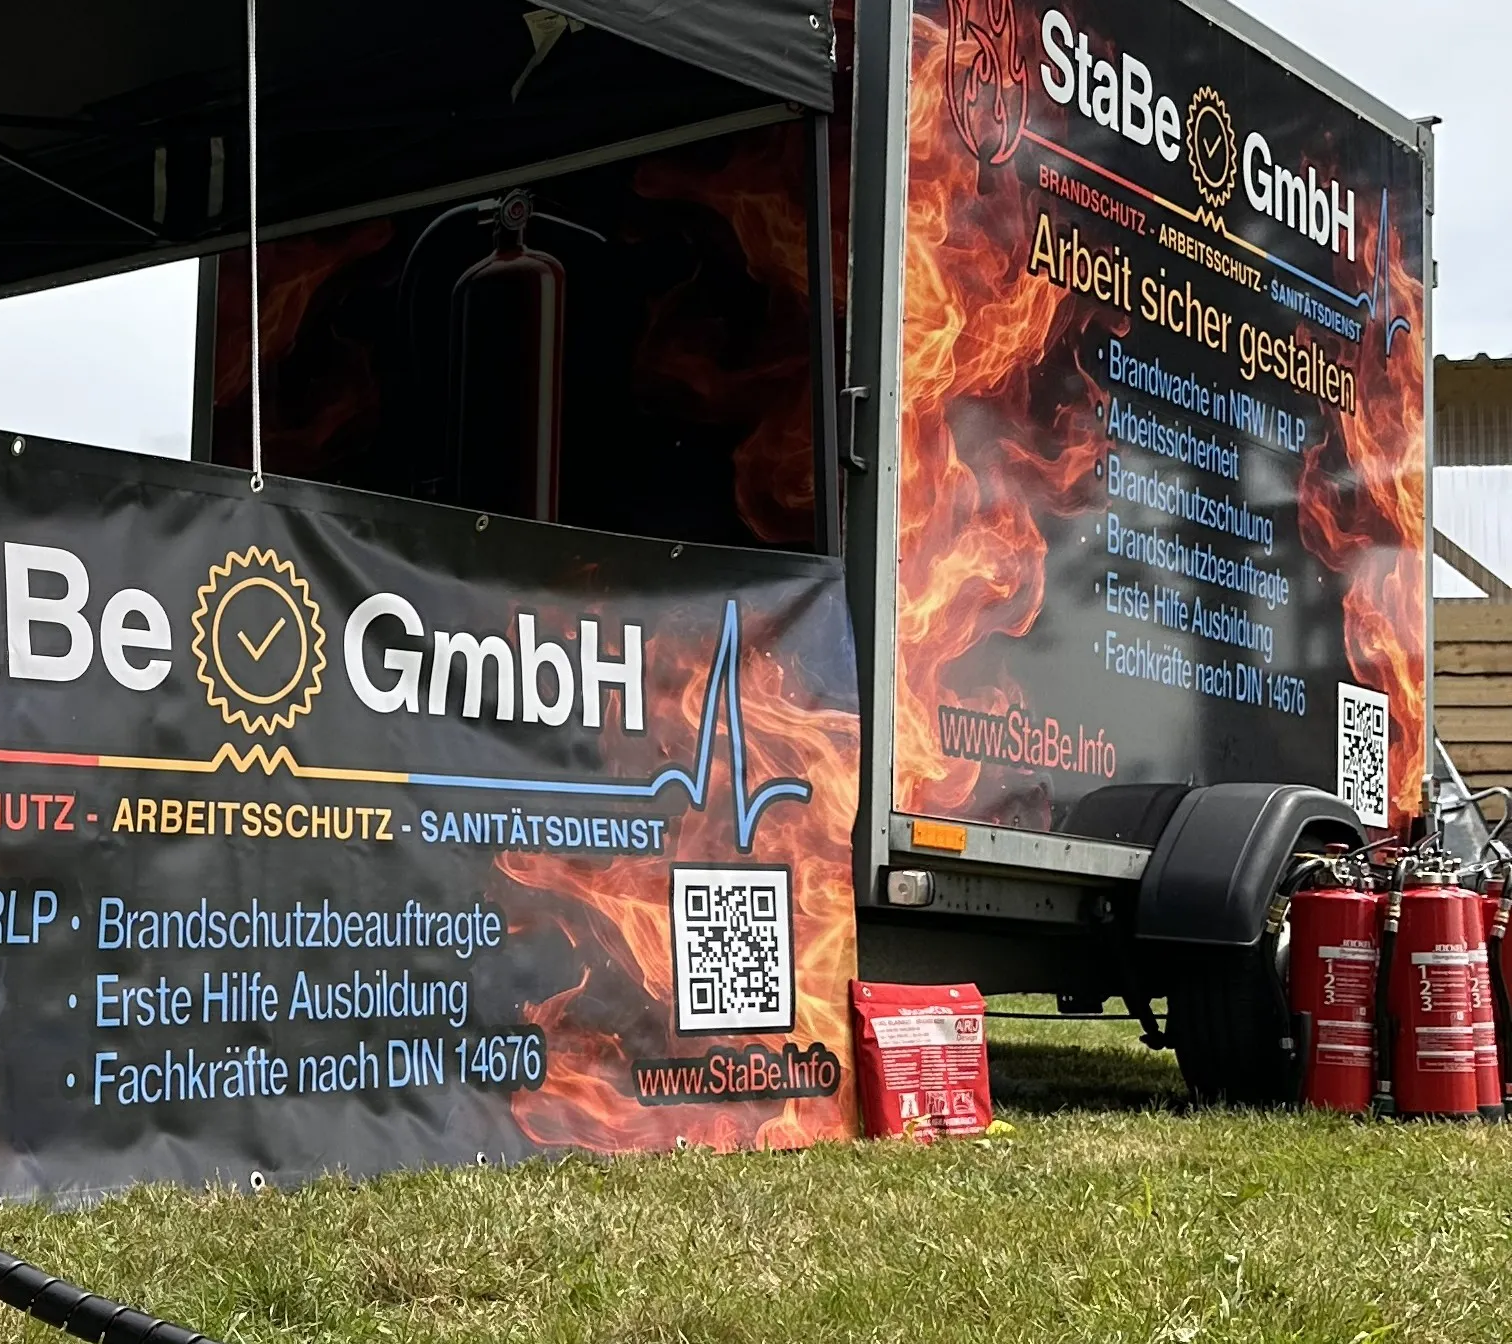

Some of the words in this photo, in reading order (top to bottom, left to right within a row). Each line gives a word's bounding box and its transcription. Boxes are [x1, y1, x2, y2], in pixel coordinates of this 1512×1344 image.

[1041, 10, 1182, 163] StaBe
[1242, 132, 1356, 261] GmbH
[1039, 164, 1146, 235] BRANDSCHUTZ
[1158, 223, 1262, 293] ARBEITSSCHUTZ
[1270, 278, 1362, 342] SANITÄTSDIENST
[1030, 213, 1133, 313] Arbeit
[1141, 267, 1232, 354] sicher
[1239, 322, 1357, 414] gestalten
[1109, 339, 1210, 419] Brandwache
[1212, 384, 1226, 425] in
[1229, 393, 1266, 440] NRW
[1278, 413, 1306, 455] RLP
[1108, 405, 1240, 481] Arbeitssicherheit
[1107, 454, 1274, 555] Brandschutzschulung
[1107, 514, 1290, 608] Brandschutzbeauftragte
[1106, 577, 1150, 622] Erste
[1153, 590, 1188, 633] Hilfe
[1191, 608, 1274, 663] Ausbildung
[344, 592, 646, 732] GmbH
[1105, 631, 1192, 690] Fachkräfte
[1195, 664, 1232, 700] nach
[1235, 669, 1263, 707] DIN
[1266, 674, 1306, 717] 14676
[940, 708, 1117, 779] www.StaBe.Info
[112, 798, 394, 842] ARBEITSSCHUTZ
[420, 808, 666, 851] SANITÄTSDIENST
[97, 895, 502, 957] Brandschutzbeauftragte
[95, 973, 193, 1029] Erste
[202, 970, 279, 1026] Hilfe
[289, 968, 469, 1029] Ausbildung
[1324, 973, 1336, 989] 2
[1324, 989, 1335, 1005] 3
[1418, 964, 1427, 980] 1
[1419, 980, 1432, 995] 2
[1421, 996, 1433, 1012] 3
[1470, 977, 1480, 993] 2
[1471, 992, 1482, 1008] 3
[956, 1018, 979, 1033] ARJ
[93, 1048, 289, 1106] Fachkräfte
[297, 1042, 381, 1094] nach
[388, 1037, 446, 1089] DIN
[455, 1033, 543, 1085] 14676
[636, 1052, 837, 1098] www.StaBe.Info
